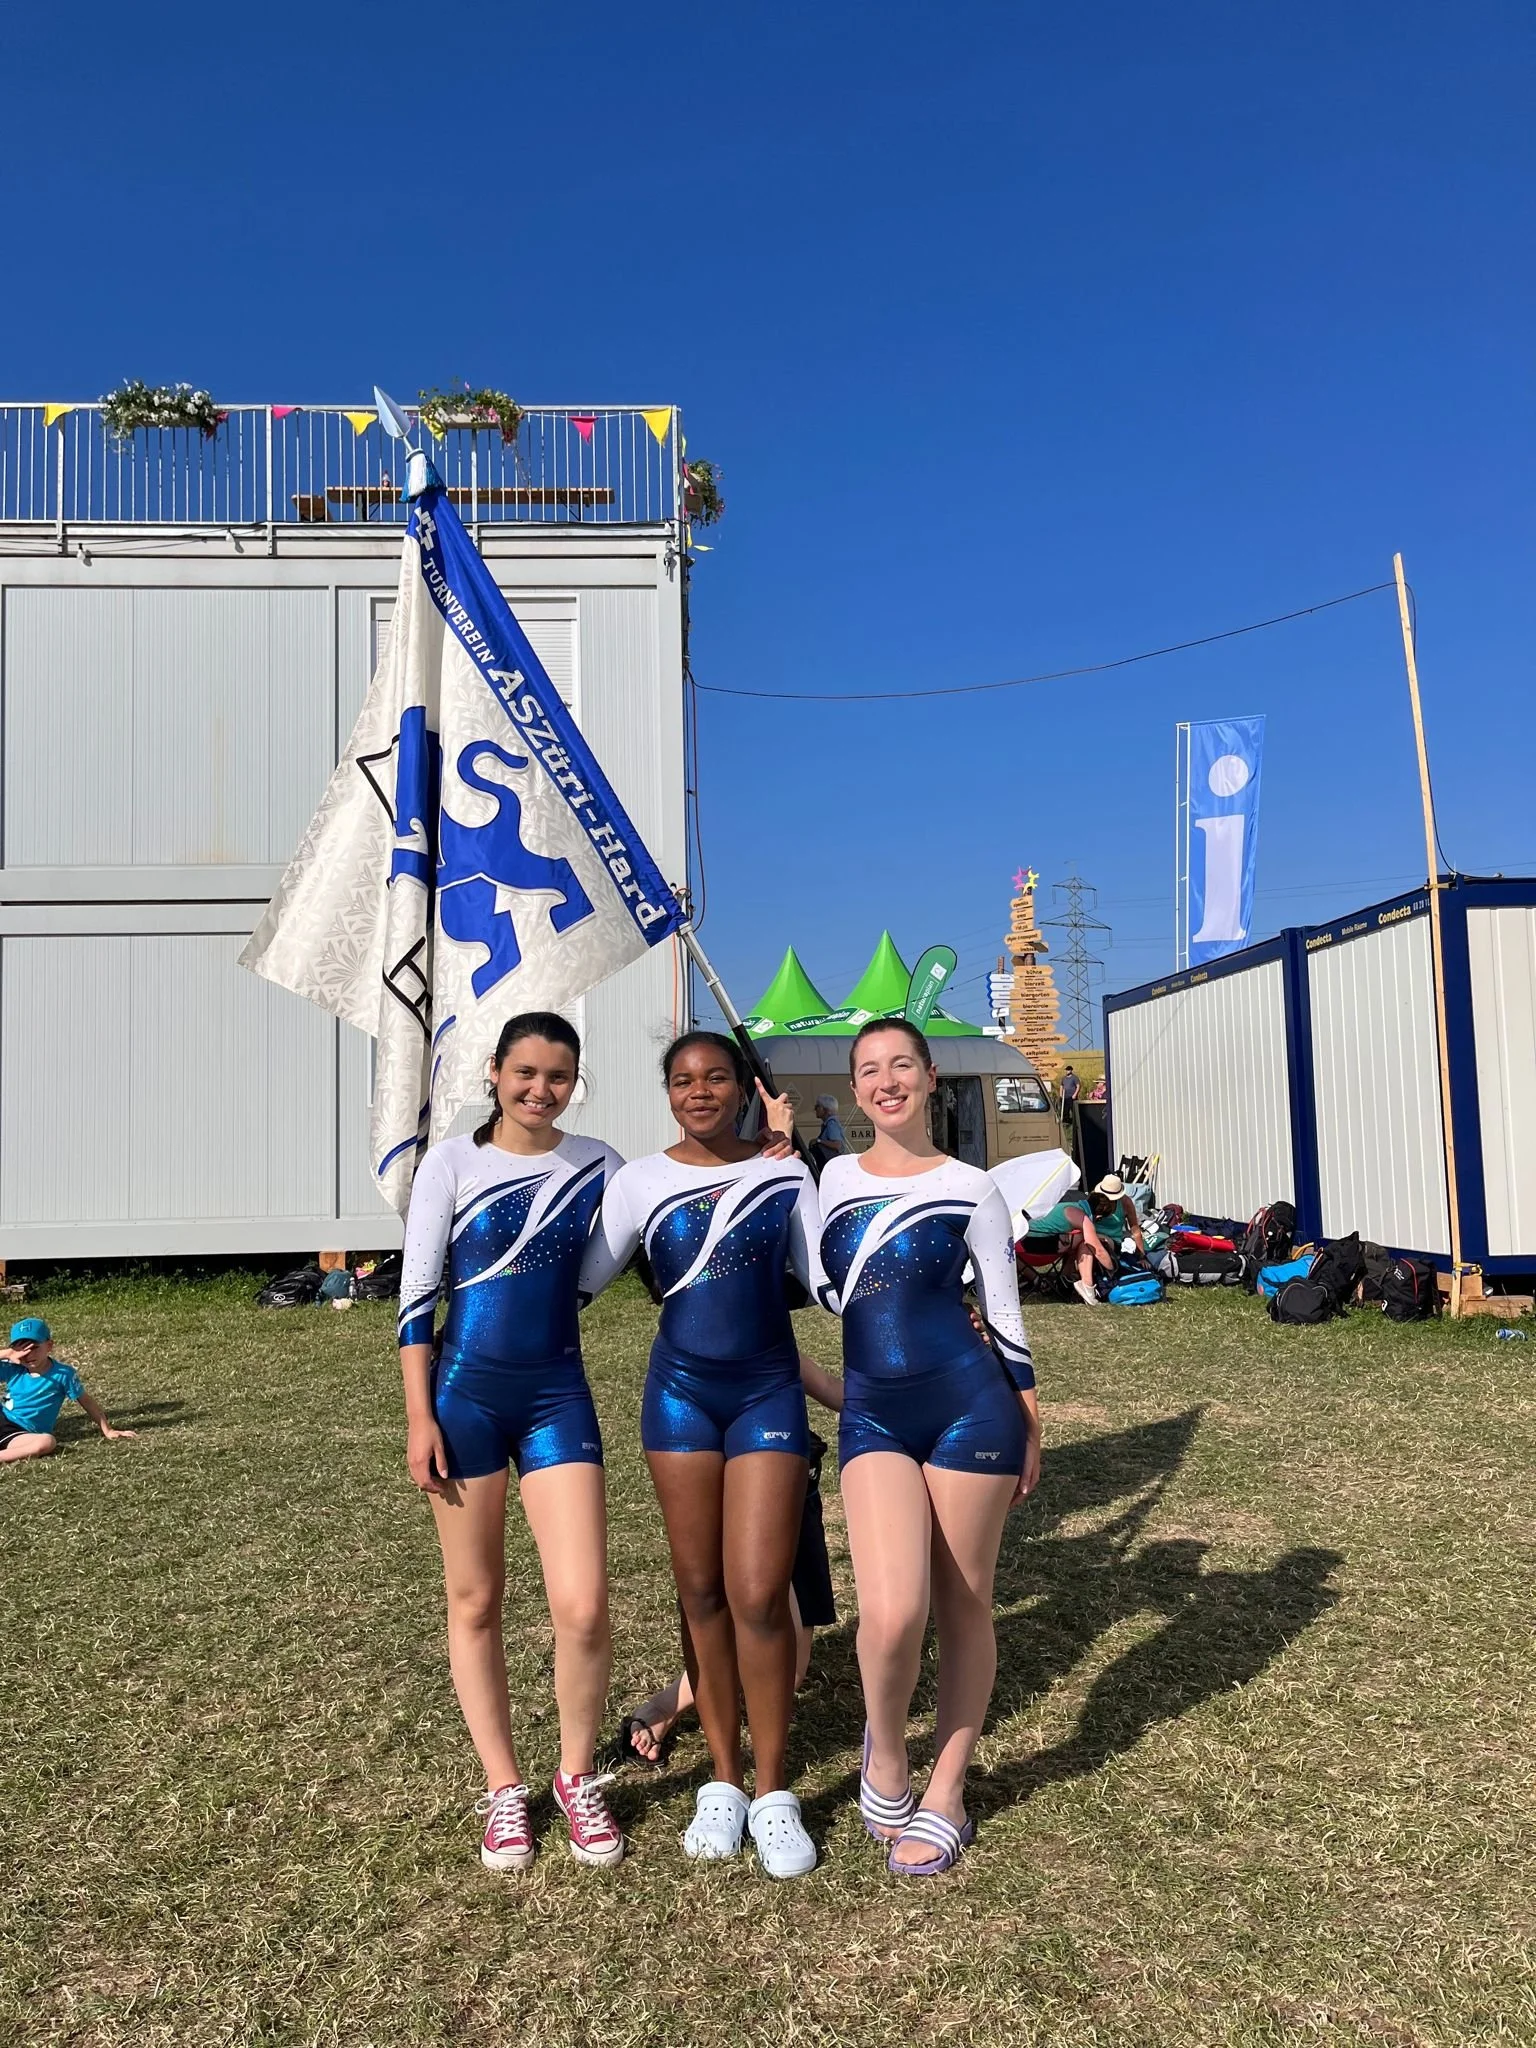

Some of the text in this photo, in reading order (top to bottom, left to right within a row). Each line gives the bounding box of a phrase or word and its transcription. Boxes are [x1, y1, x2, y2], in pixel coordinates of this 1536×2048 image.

[423, 557, 495, 663] TURNVEREIN
[1193, 755, 1250, 944] i
[1305, 932, 1332, 950] Condecta
[1378, 904, 1412, 925] Condecta
